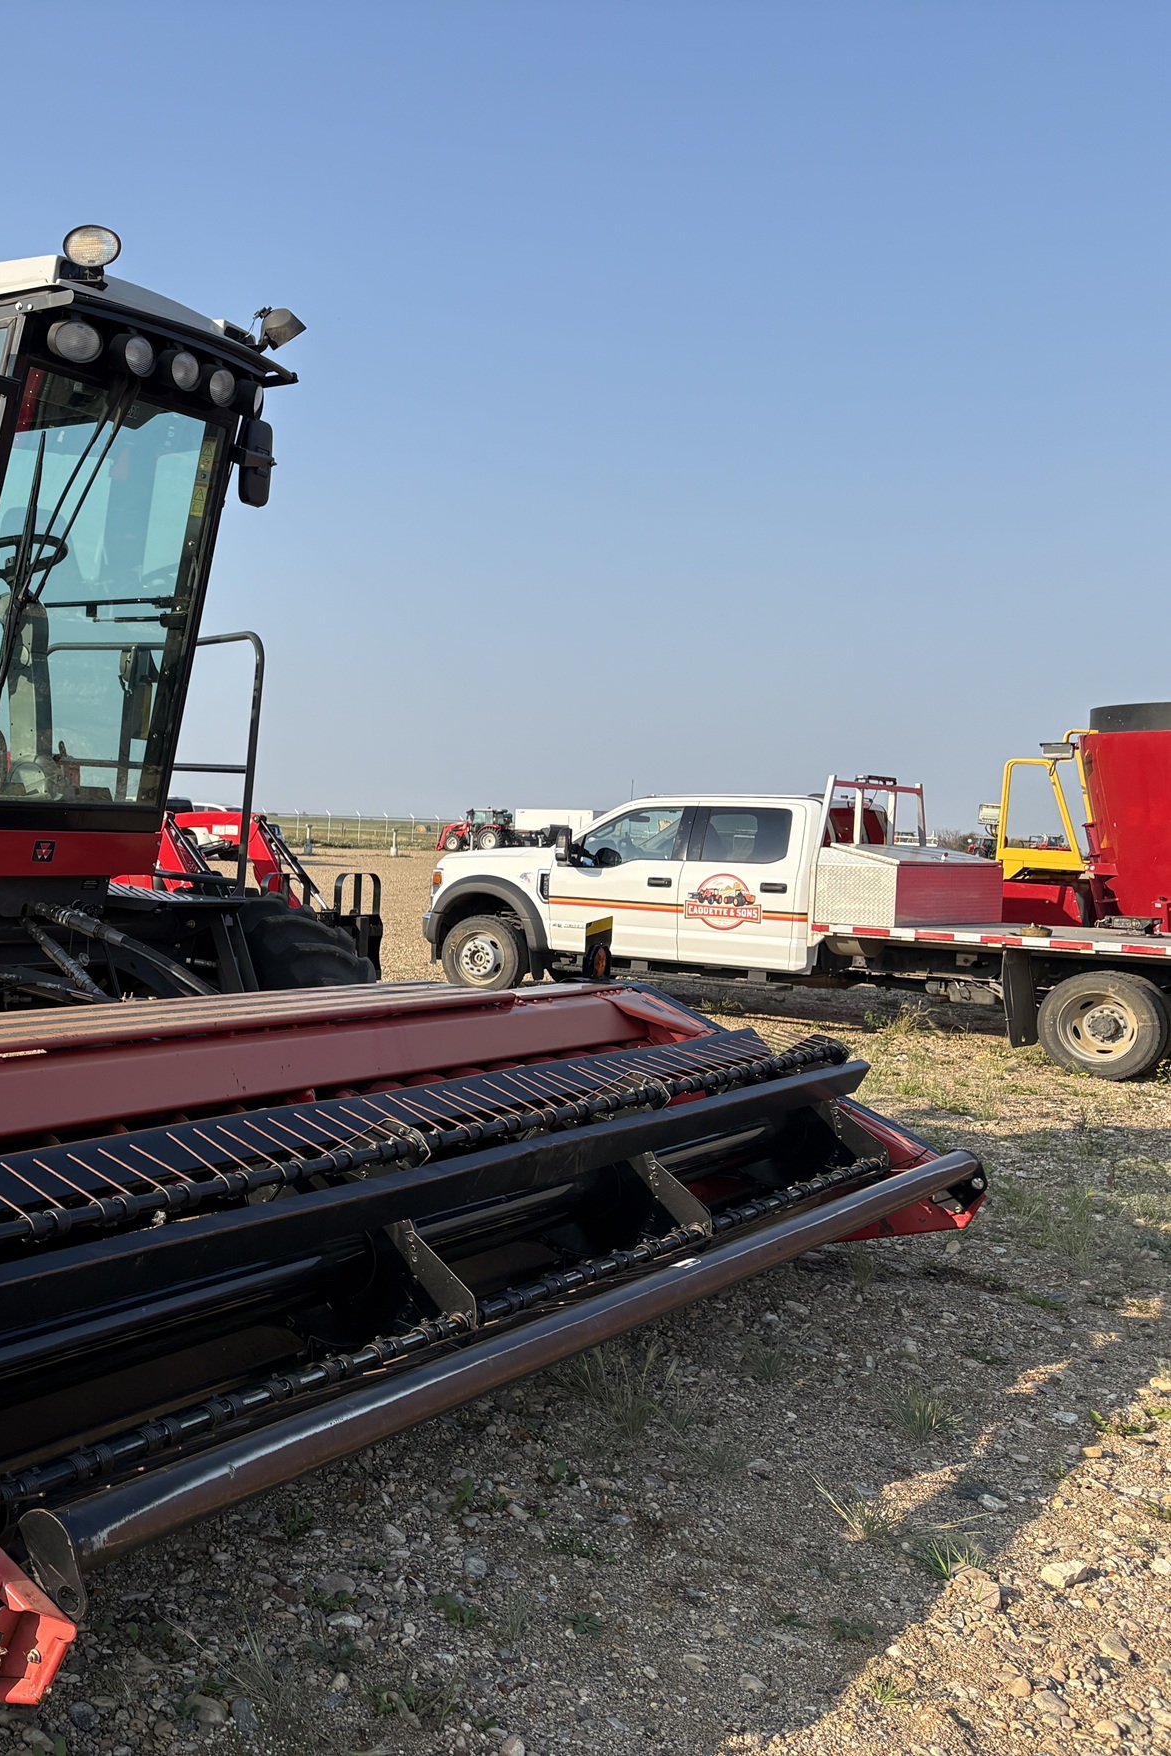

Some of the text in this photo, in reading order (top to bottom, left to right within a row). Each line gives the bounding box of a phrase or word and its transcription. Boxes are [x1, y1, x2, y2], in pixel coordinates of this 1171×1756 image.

[688, 905, 758, 919] CAOUETTE & SONS
